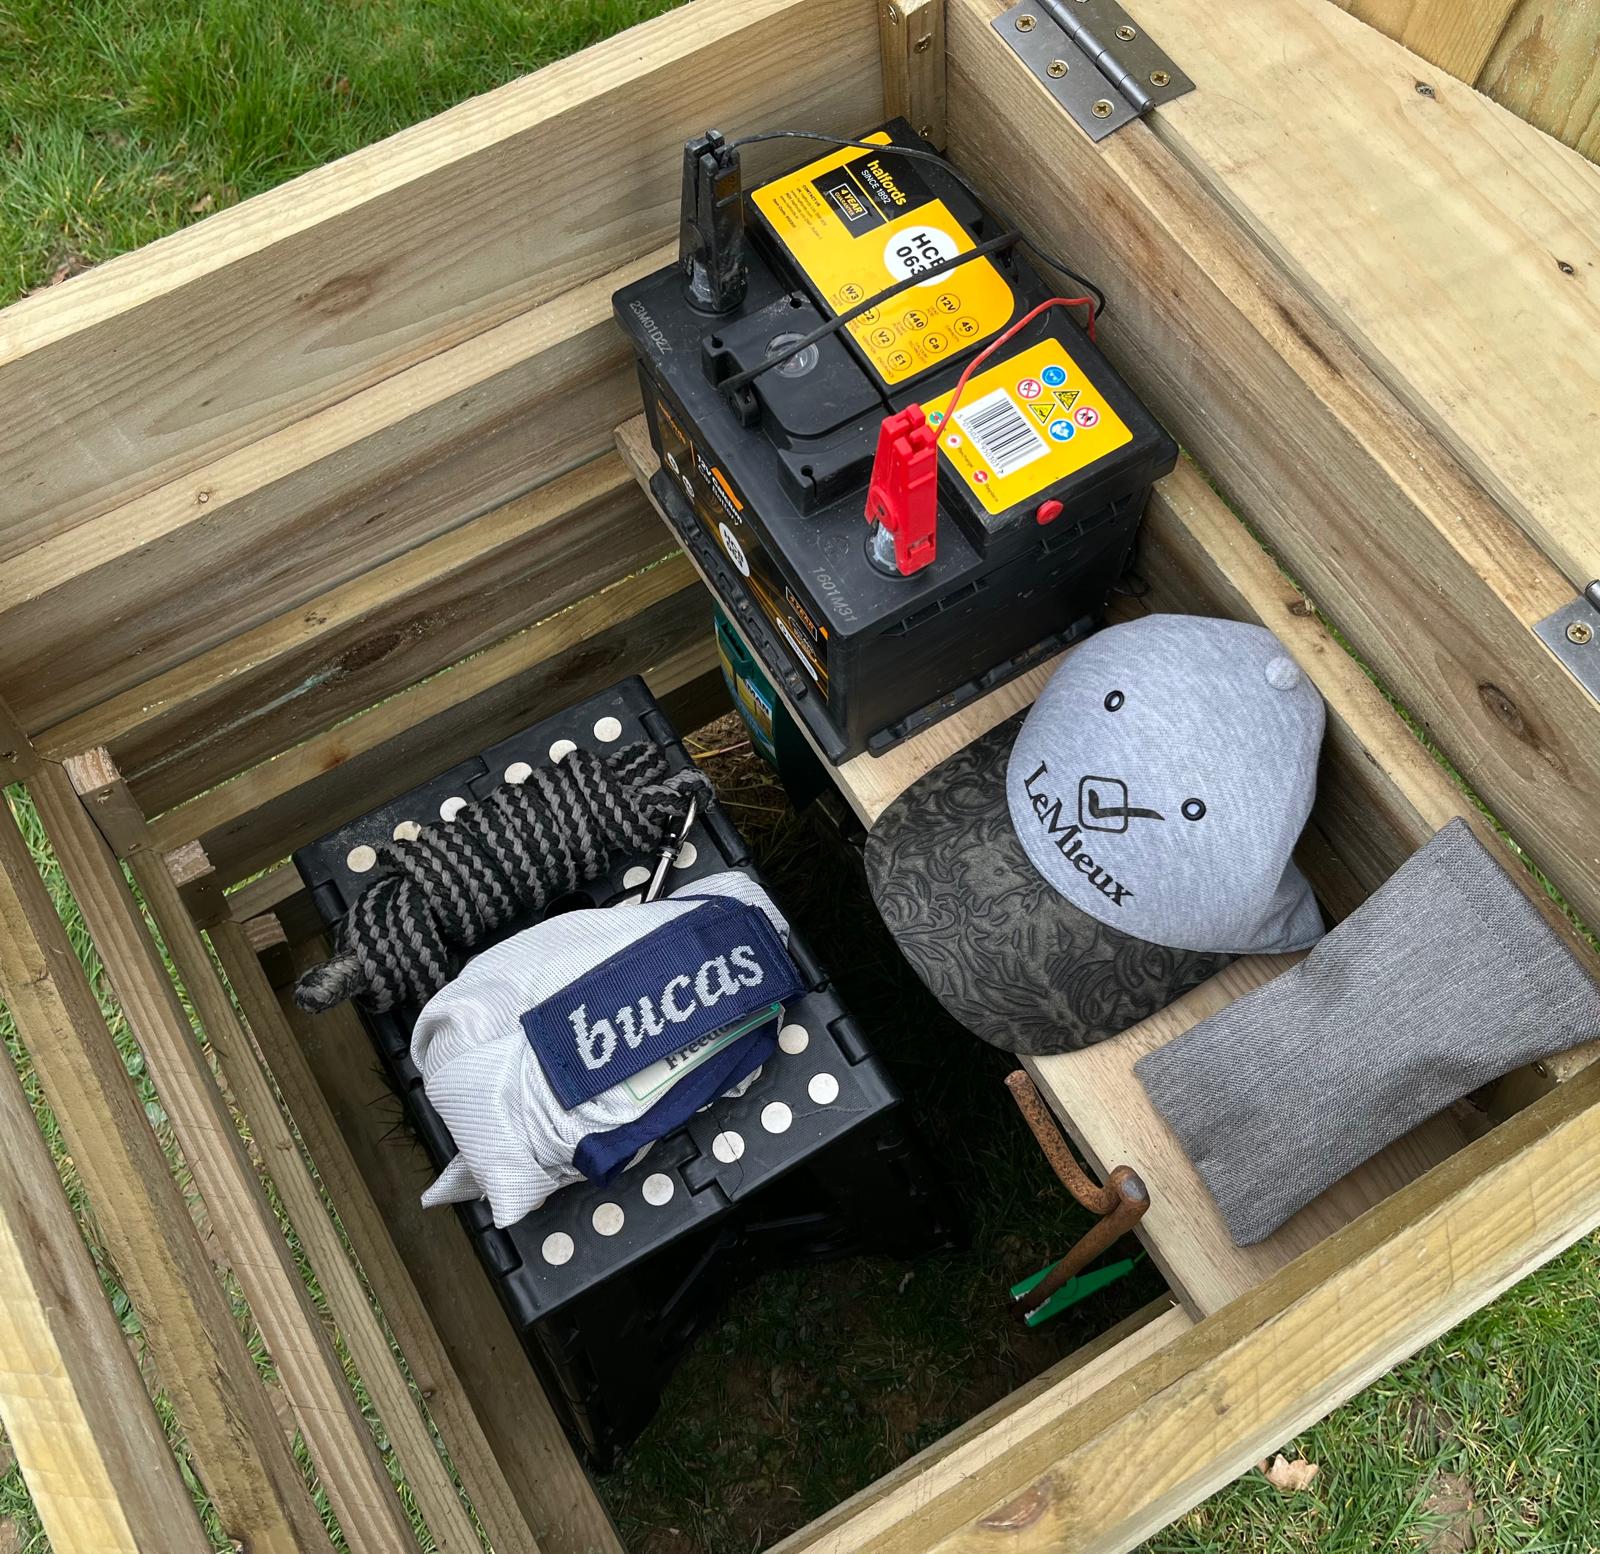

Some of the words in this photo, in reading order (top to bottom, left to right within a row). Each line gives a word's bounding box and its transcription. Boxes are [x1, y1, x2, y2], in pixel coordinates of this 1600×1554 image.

[861, 169, 880, 190] SINCE
[875, 187, 892, 204] 1892
[867, 160, 906, 205] halfords
[841, 188, 849, 196] 4
[844, 193, 862, 214] YEAR
[896, 246, 928, 276] 063
[845, 285, 859, 300] W3
[940, 296, 955, 311] 12V
[909, 312, 924, 329] 440
[961, 320, 973, 332] 45
[877, 331, 890, 344] V2
[929, 337, 941, 350] Ca
[894, 354, 906, 365] E1
[813, 566, 858, 622] 1601M31
[1024, 760, 1134, 907] LeMieux
[568, 944, 765, 1070] bucas
